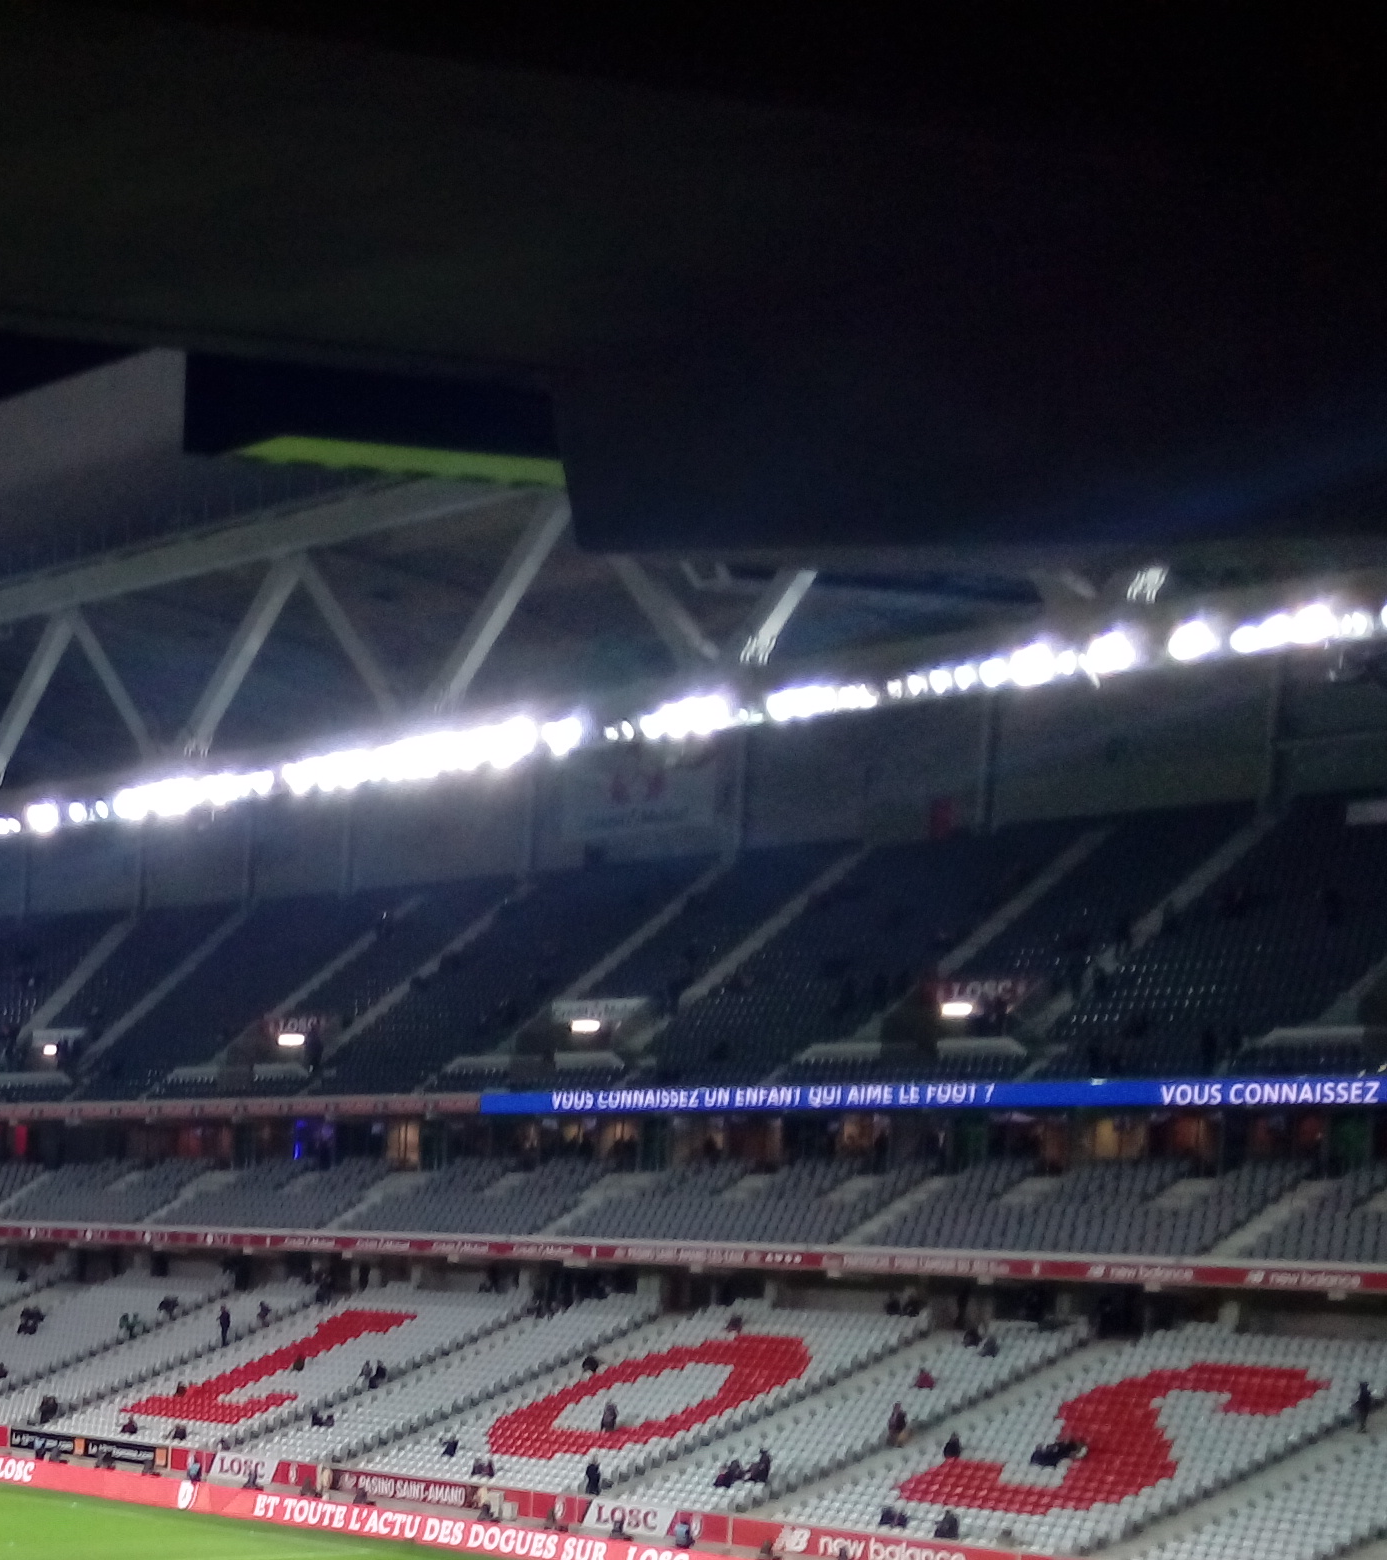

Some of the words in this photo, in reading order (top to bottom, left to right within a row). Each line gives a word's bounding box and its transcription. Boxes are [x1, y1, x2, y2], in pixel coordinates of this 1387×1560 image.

[552, 1091, 594, 1110] VOUS
[598, 1088, 698, 1109] CONNAISSEZ
[704, 1088, 730, 1107] UN
[734, 1086, 802, 1107] ENFANT
[808, 1086, 842, 1108] QUI
[846, 1085, 893, 1105] AIME
[898, 1084, 920, 1104] LE
[926, 1083, 976, 1104] FOOT
[1161, 1083, 1222, 1106] VOUS
[1229, 1081, 1380, 1105] CONNAISSEZ
[218, 1456, 266, 1479] LOSC
[253, 1494, 280, 1518] ET
[283, 1499, 348, 1528] TOUTE
[347, 1508, 423, 1539] L'ACTU
[422, 1517, 465, 1546] DES
[467, 1524, 559, 1559] DOGUES
[595, 1503, 659, 1531] LOSC
[818, 1536, 864, 1560] new
